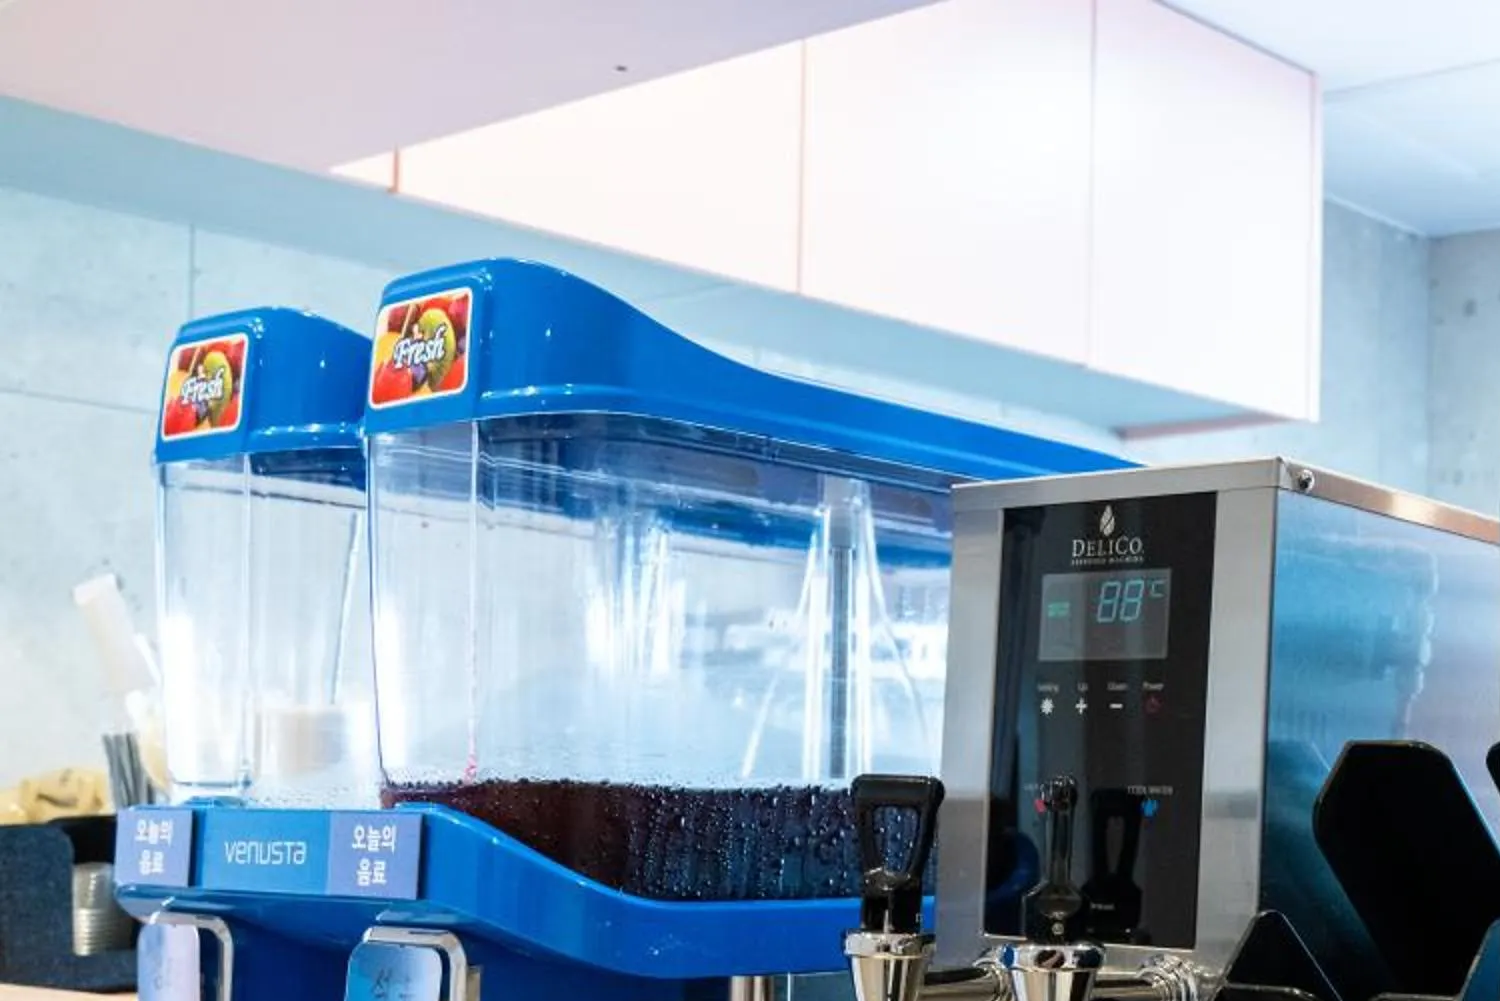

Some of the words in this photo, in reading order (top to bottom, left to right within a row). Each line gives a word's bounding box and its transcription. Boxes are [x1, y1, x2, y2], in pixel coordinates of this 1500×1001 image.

[393, 324, 446, 369] Fresh
[181, 368, 224, 404] Fresh
[135, 818, 174, 848] 오늘의
[351, 823, 398, 854] 오늘의
[138, 849, 165, 876] 음료
[356, 858, 388, 887] 음료
